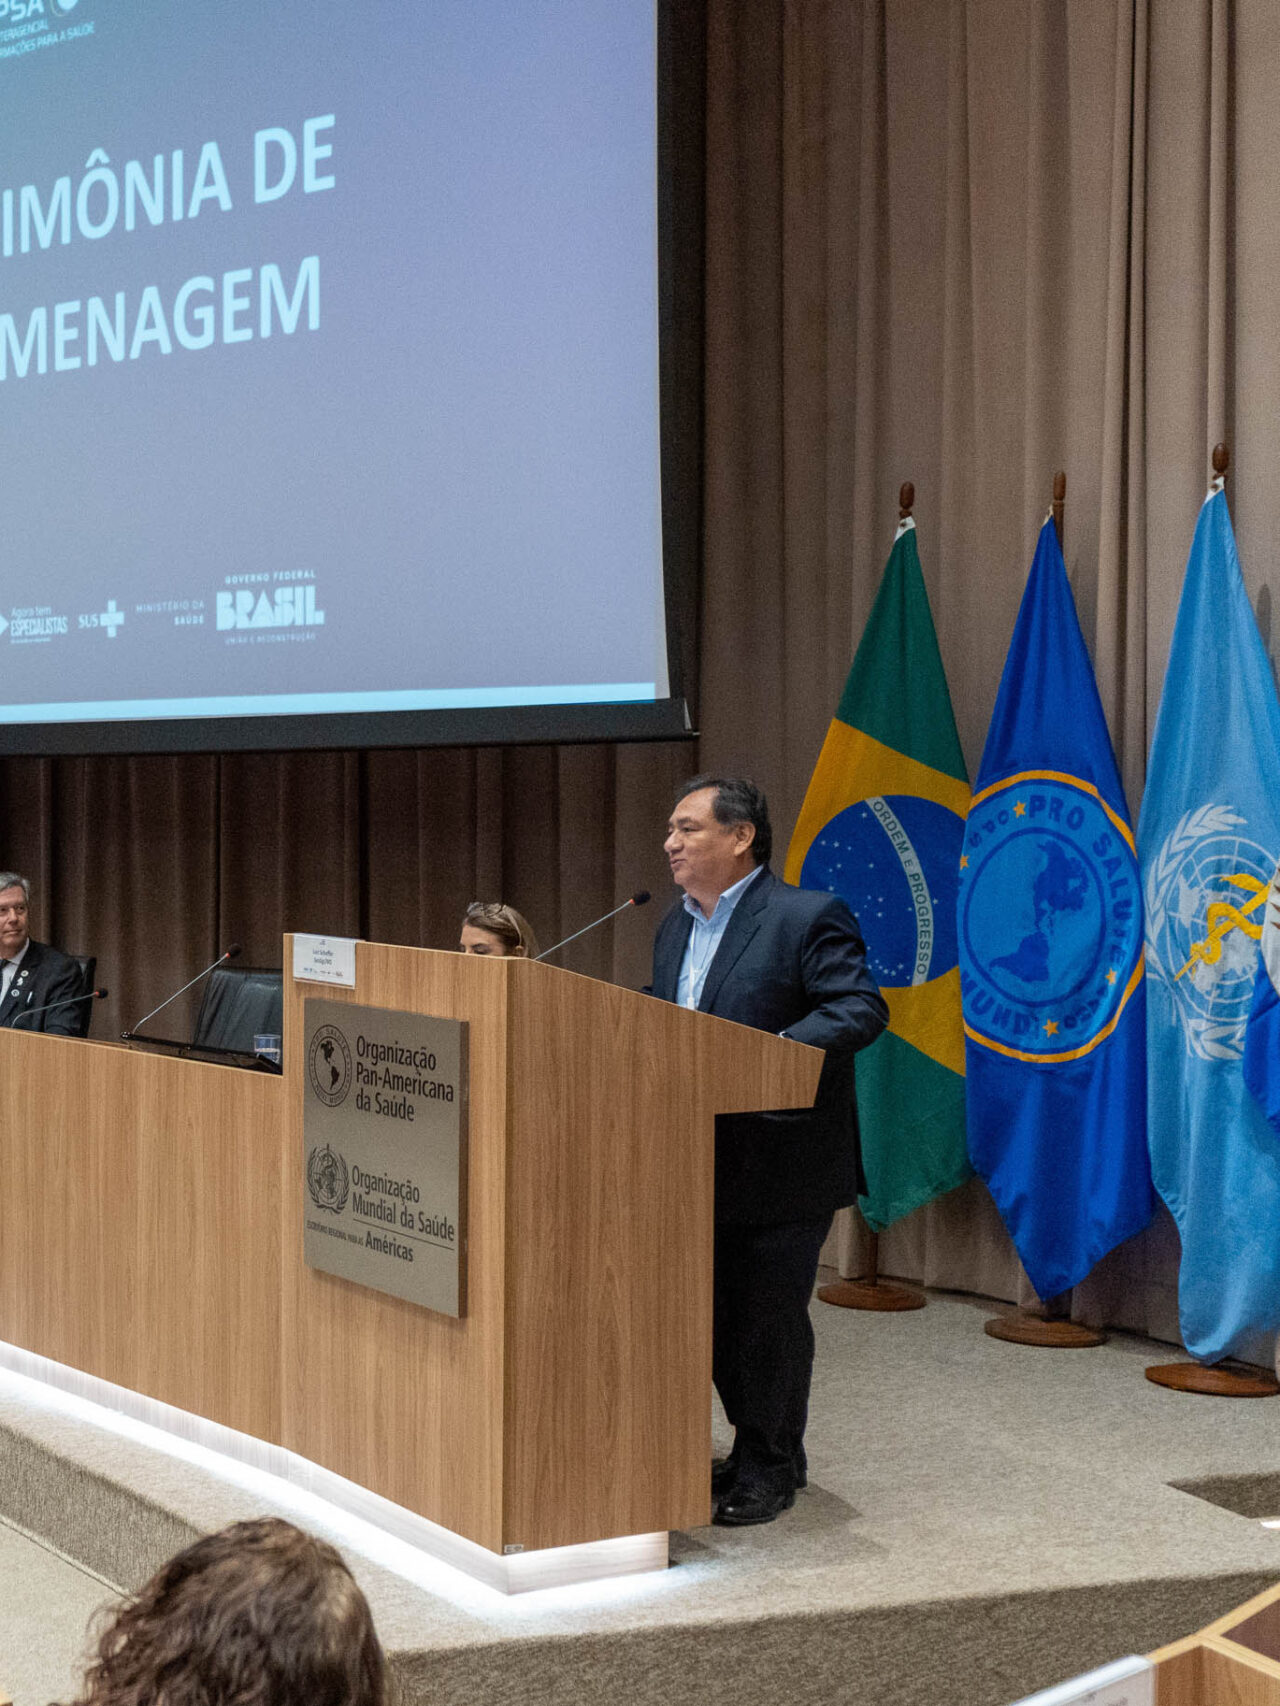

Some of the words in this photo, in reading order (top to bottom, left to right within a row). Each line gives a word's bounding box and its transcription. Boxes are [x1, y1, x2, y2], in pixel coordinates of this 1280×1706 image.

[254, 114, 336, 204] DE
[225, 573, 269, 585] GOVERNO
[273, 569, 316, 581] FEDERAL
[78, 613, 99, 629] SUS
[216, 585, 325, 631] BRASIL
[1029, 794, 1085, 831] PRO
[873, 800, 910, 854] ORDEM
[904, 859, 914, 868] E
[909, 872, 932, 975] PROGRESSO
[356, 1035, 437, 1073] Organização
[356, 1062, 454, 1102] Pan-Americana
[356, 1088, 371, 1112] da
[375, 1092, 415, 1122] Saúde
[352, 1165, 420, 1205] Organização
[352, 1192, 396, 1225] Mundial
[400, 1204, 415, 1230] da
[418, 1211, 455, 1242] Saúde
[365, 1231, 414, 1262] Américas
